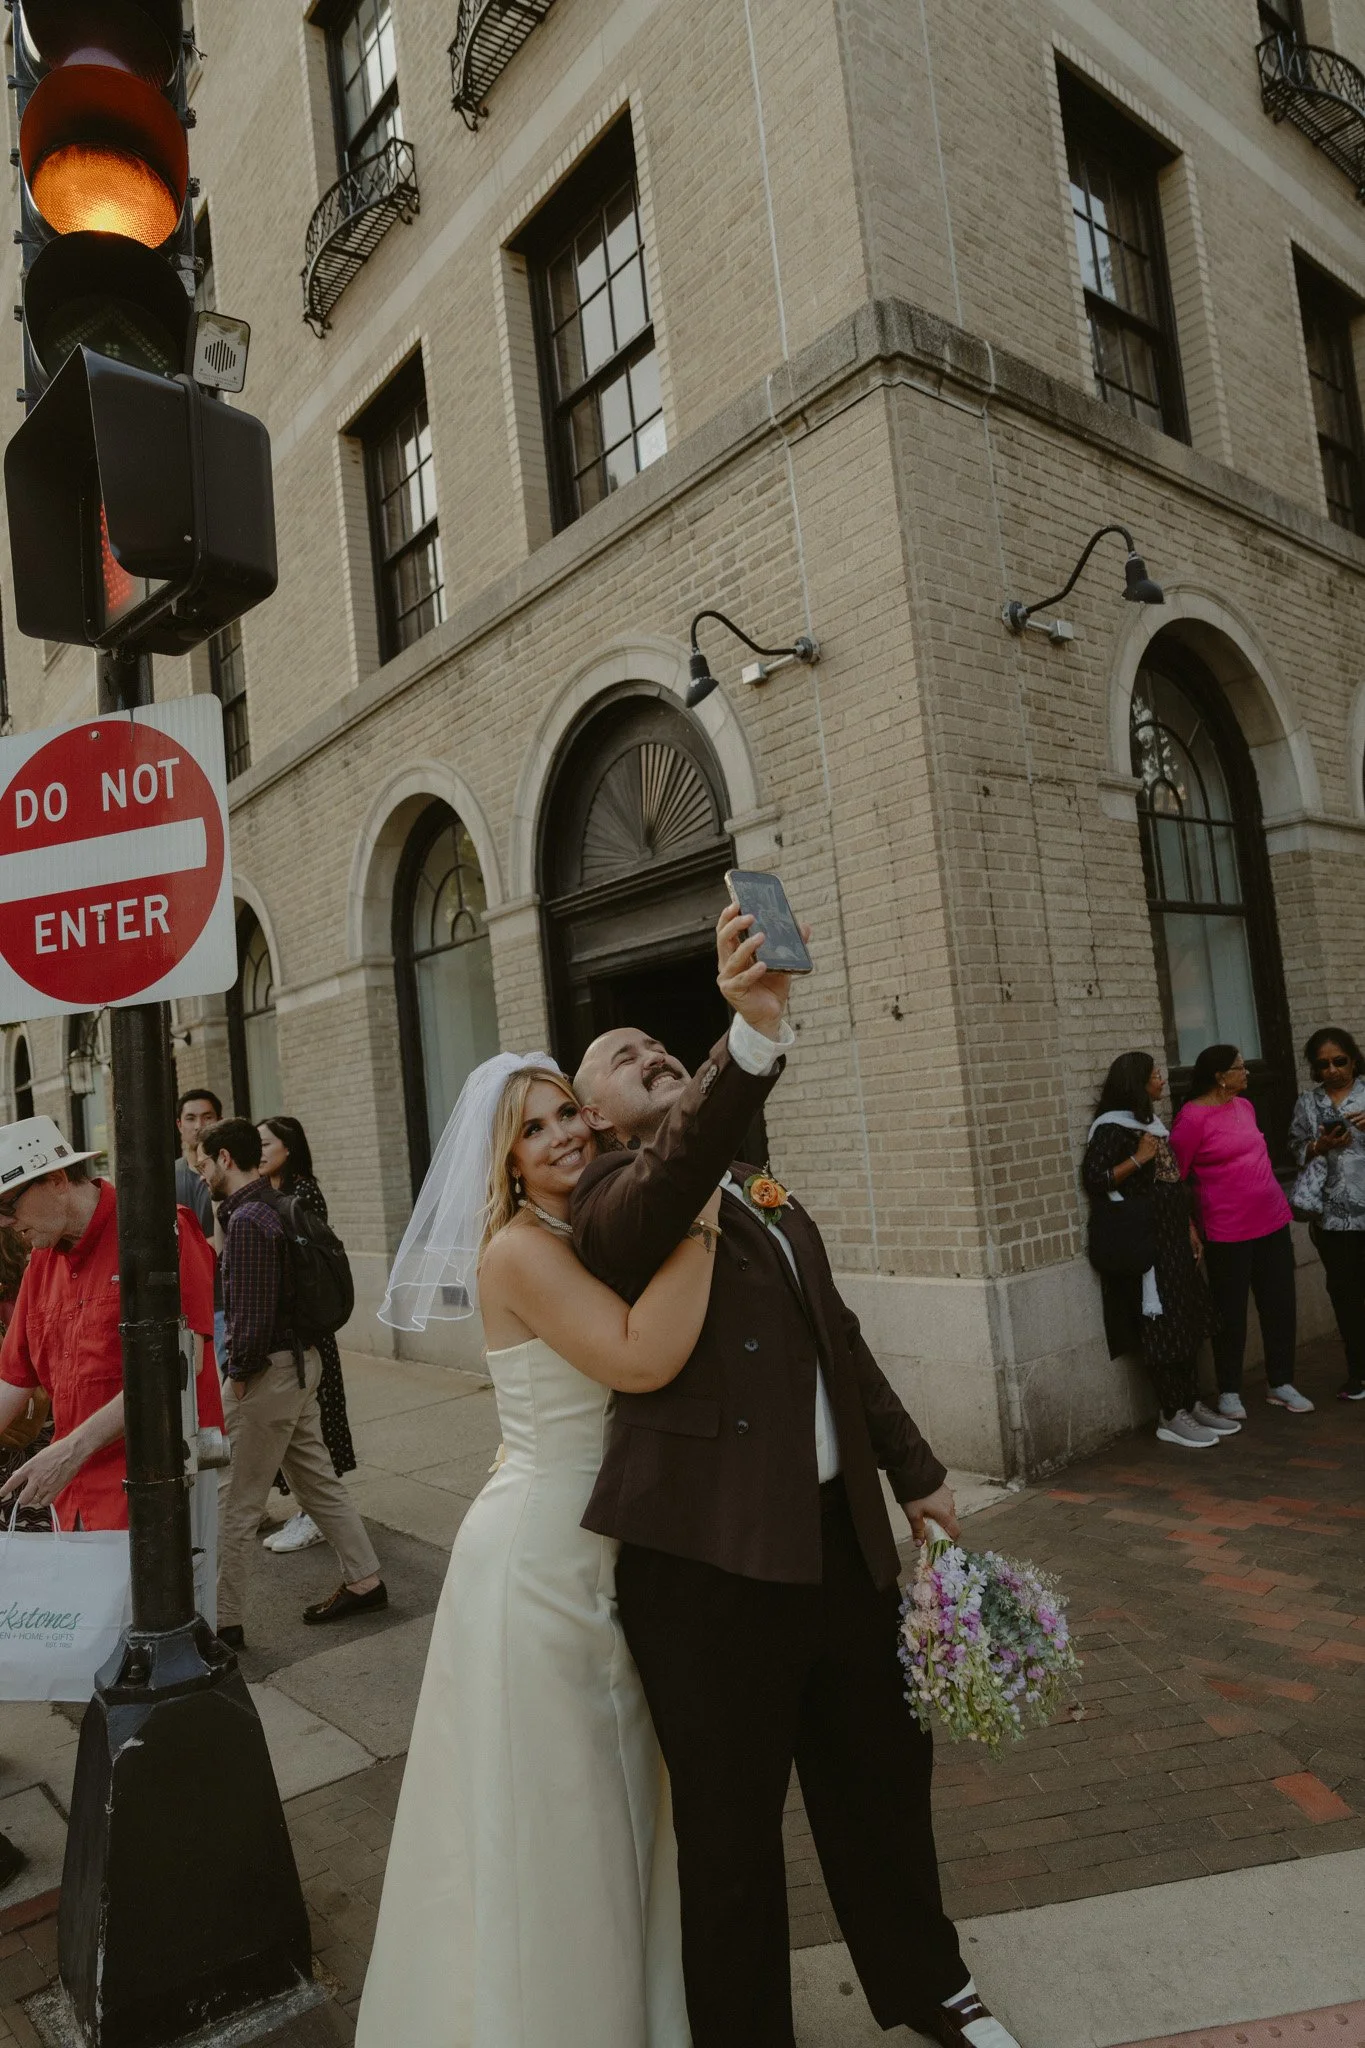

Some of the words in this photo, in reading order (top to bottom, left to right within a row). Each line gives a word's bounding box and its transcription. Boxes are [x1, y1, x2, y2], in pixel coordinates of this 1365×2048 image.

[15, 782, 68, 829] DO
[101, 757, 180, 812] NOT
[35, 894, 171, 955] ENTER
[19, 1632, 43, 1640] HOME
[52, 1633, 74, 1641] GIFTS
